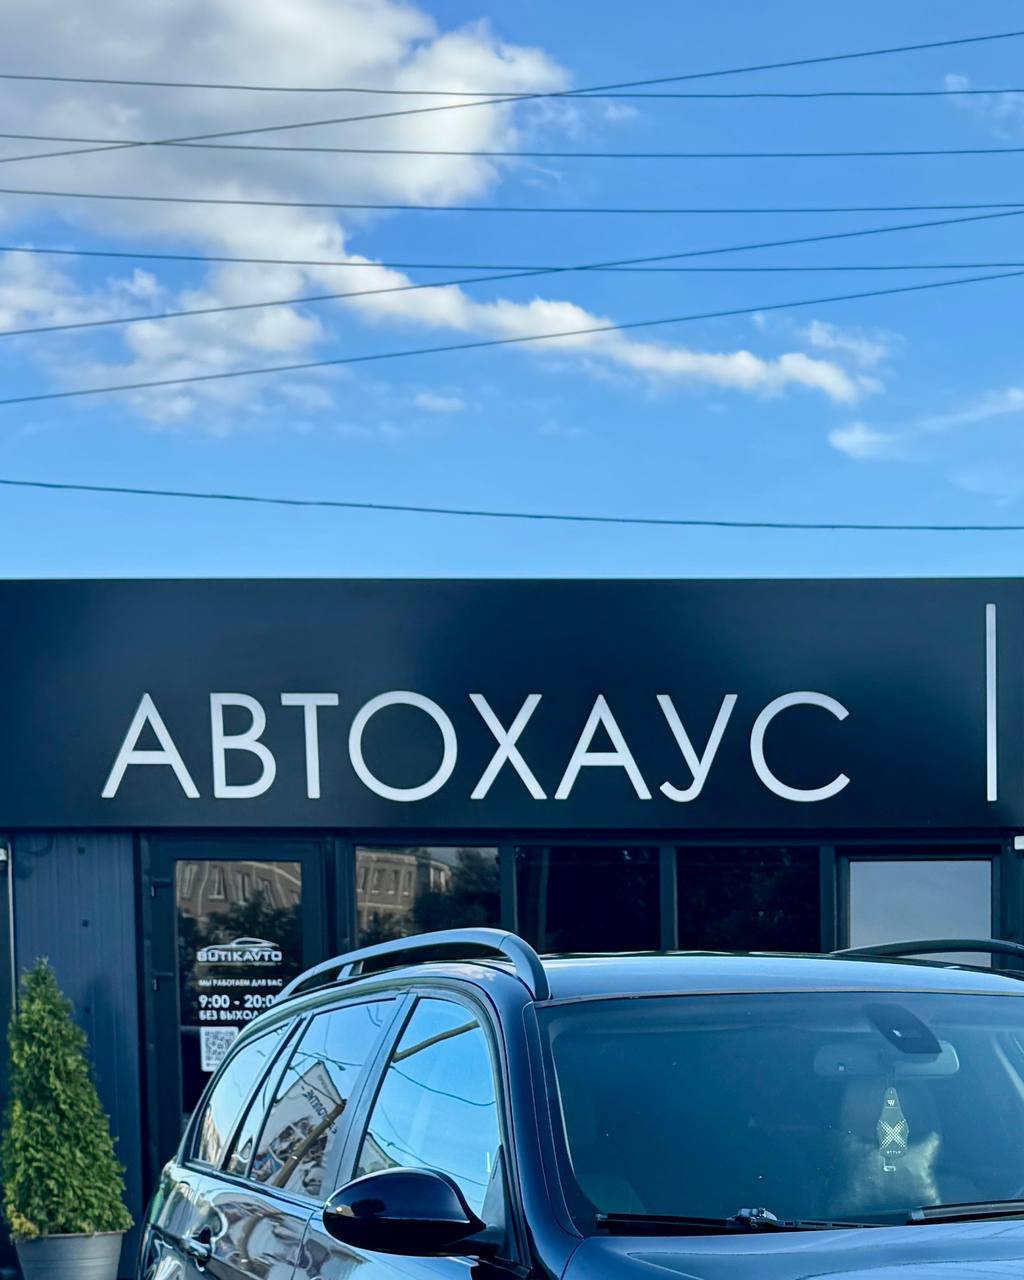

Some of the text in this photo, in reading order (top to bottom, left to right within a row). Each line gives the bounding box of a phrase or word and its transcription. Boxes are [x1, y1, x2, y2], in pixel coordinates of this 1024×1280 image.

[101, 690, 850, 802] АВТОХАУС
[197, 950, 282, 961] BUTIKAVTO
[199, 994, 230, 1008] 9:00
[244, 994, 277, 1008] 20:0
[199, 1010, 218, 1021] БЕЗ
